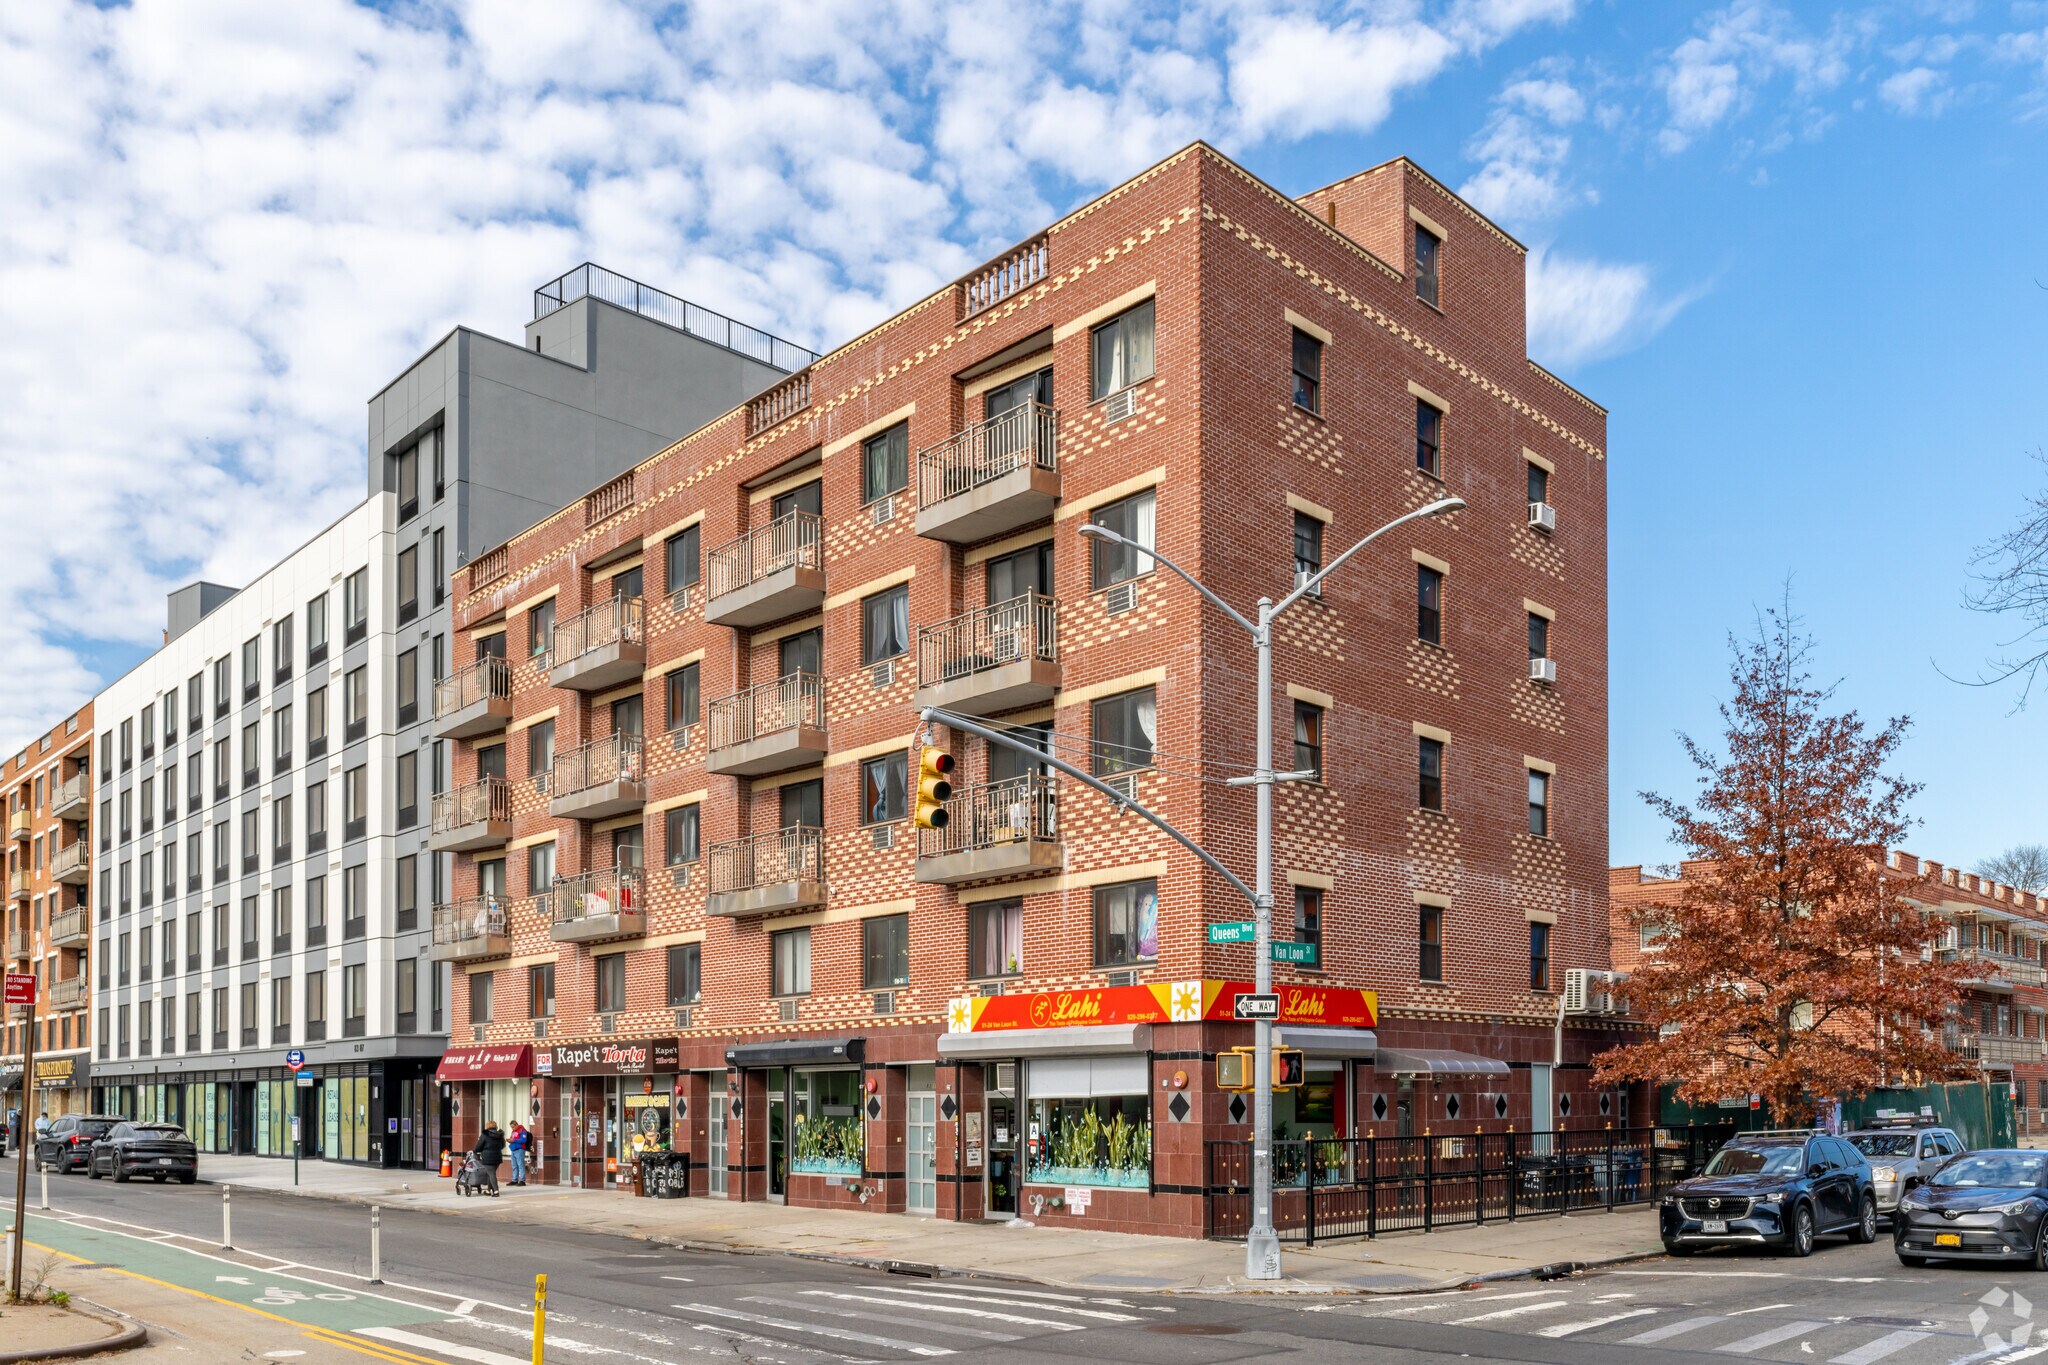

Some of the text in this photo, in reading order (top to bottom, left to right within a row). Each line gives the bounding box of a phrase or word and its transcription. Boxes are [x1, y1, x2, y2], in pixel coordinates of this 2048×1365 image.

[1212, 923, 1253, 941] Queens Blvd
[1274, 945, 1311, 960] Van Loon St
[1052, 992, 1102, 1021] Lahi
[1241, 1001, 1272, 1012] ONE WAY
[1284, 989, 1326, 1016] Lahi
[556, 1044, 646, 1068] Kape't Torta
[655, 1047, 678, 1055] Kape't
[537, 1055, 551, 1065] FOR
[1031, 1125, 1037, 1135] A
